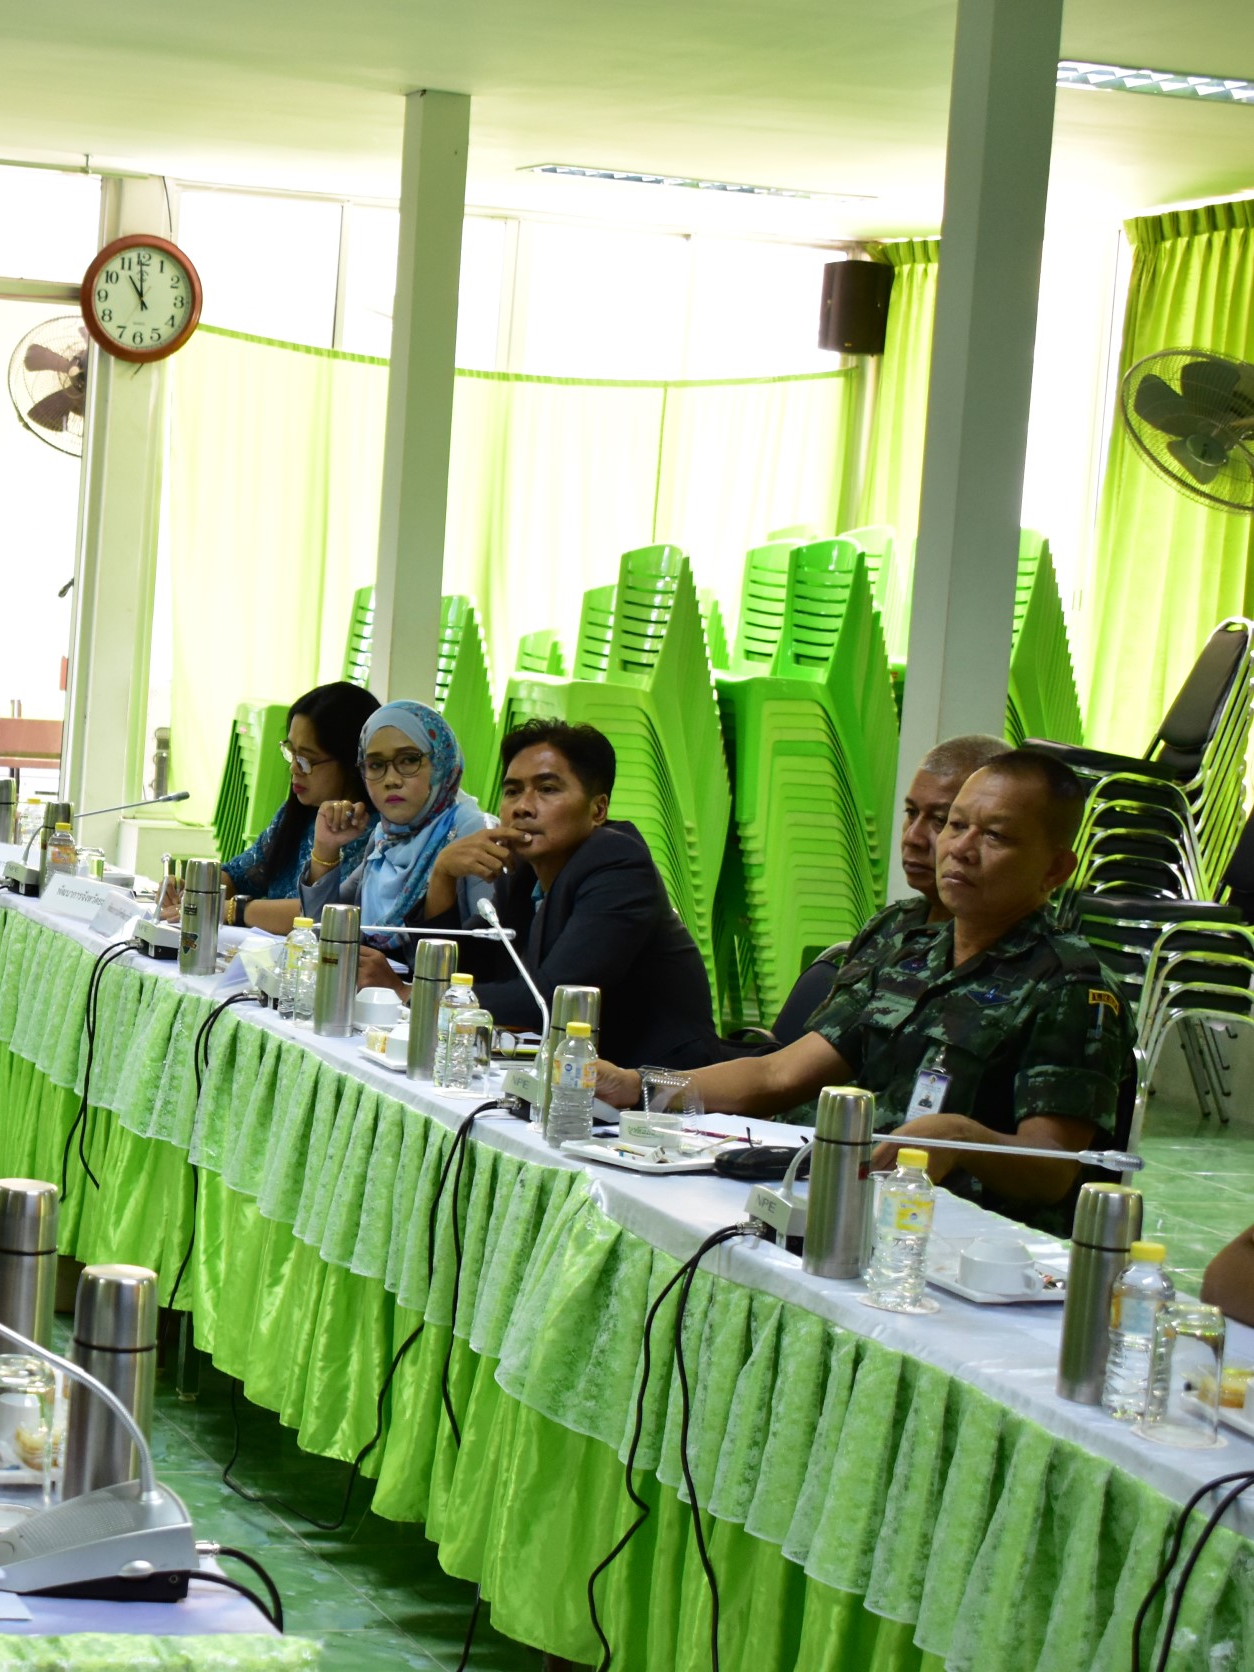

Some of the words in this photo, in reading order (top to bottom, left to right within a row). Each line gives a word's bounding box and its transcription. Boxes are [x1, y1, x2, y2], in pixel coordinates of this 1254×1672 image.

[121, 256, 131, 271] 11
[137, 252, 151, 266] 12
[159, 260, 164, 273] 1
[105, 270, 119, 284] 10
[170, 276, 180, 289] 2
[97, 289, 108, 302] 9
[173, 295, 184, 309] 3
[101, 308, 112, 322] 8
[164, 314, 175, 328] 4
[116, 325, 127, 339] 7
[132, 331, 143, 345] 6
[150, 328, 161, 341] 5
[512, 1077, 530, 1090] NPE
[757, 1194, 777, 1214] NPE
